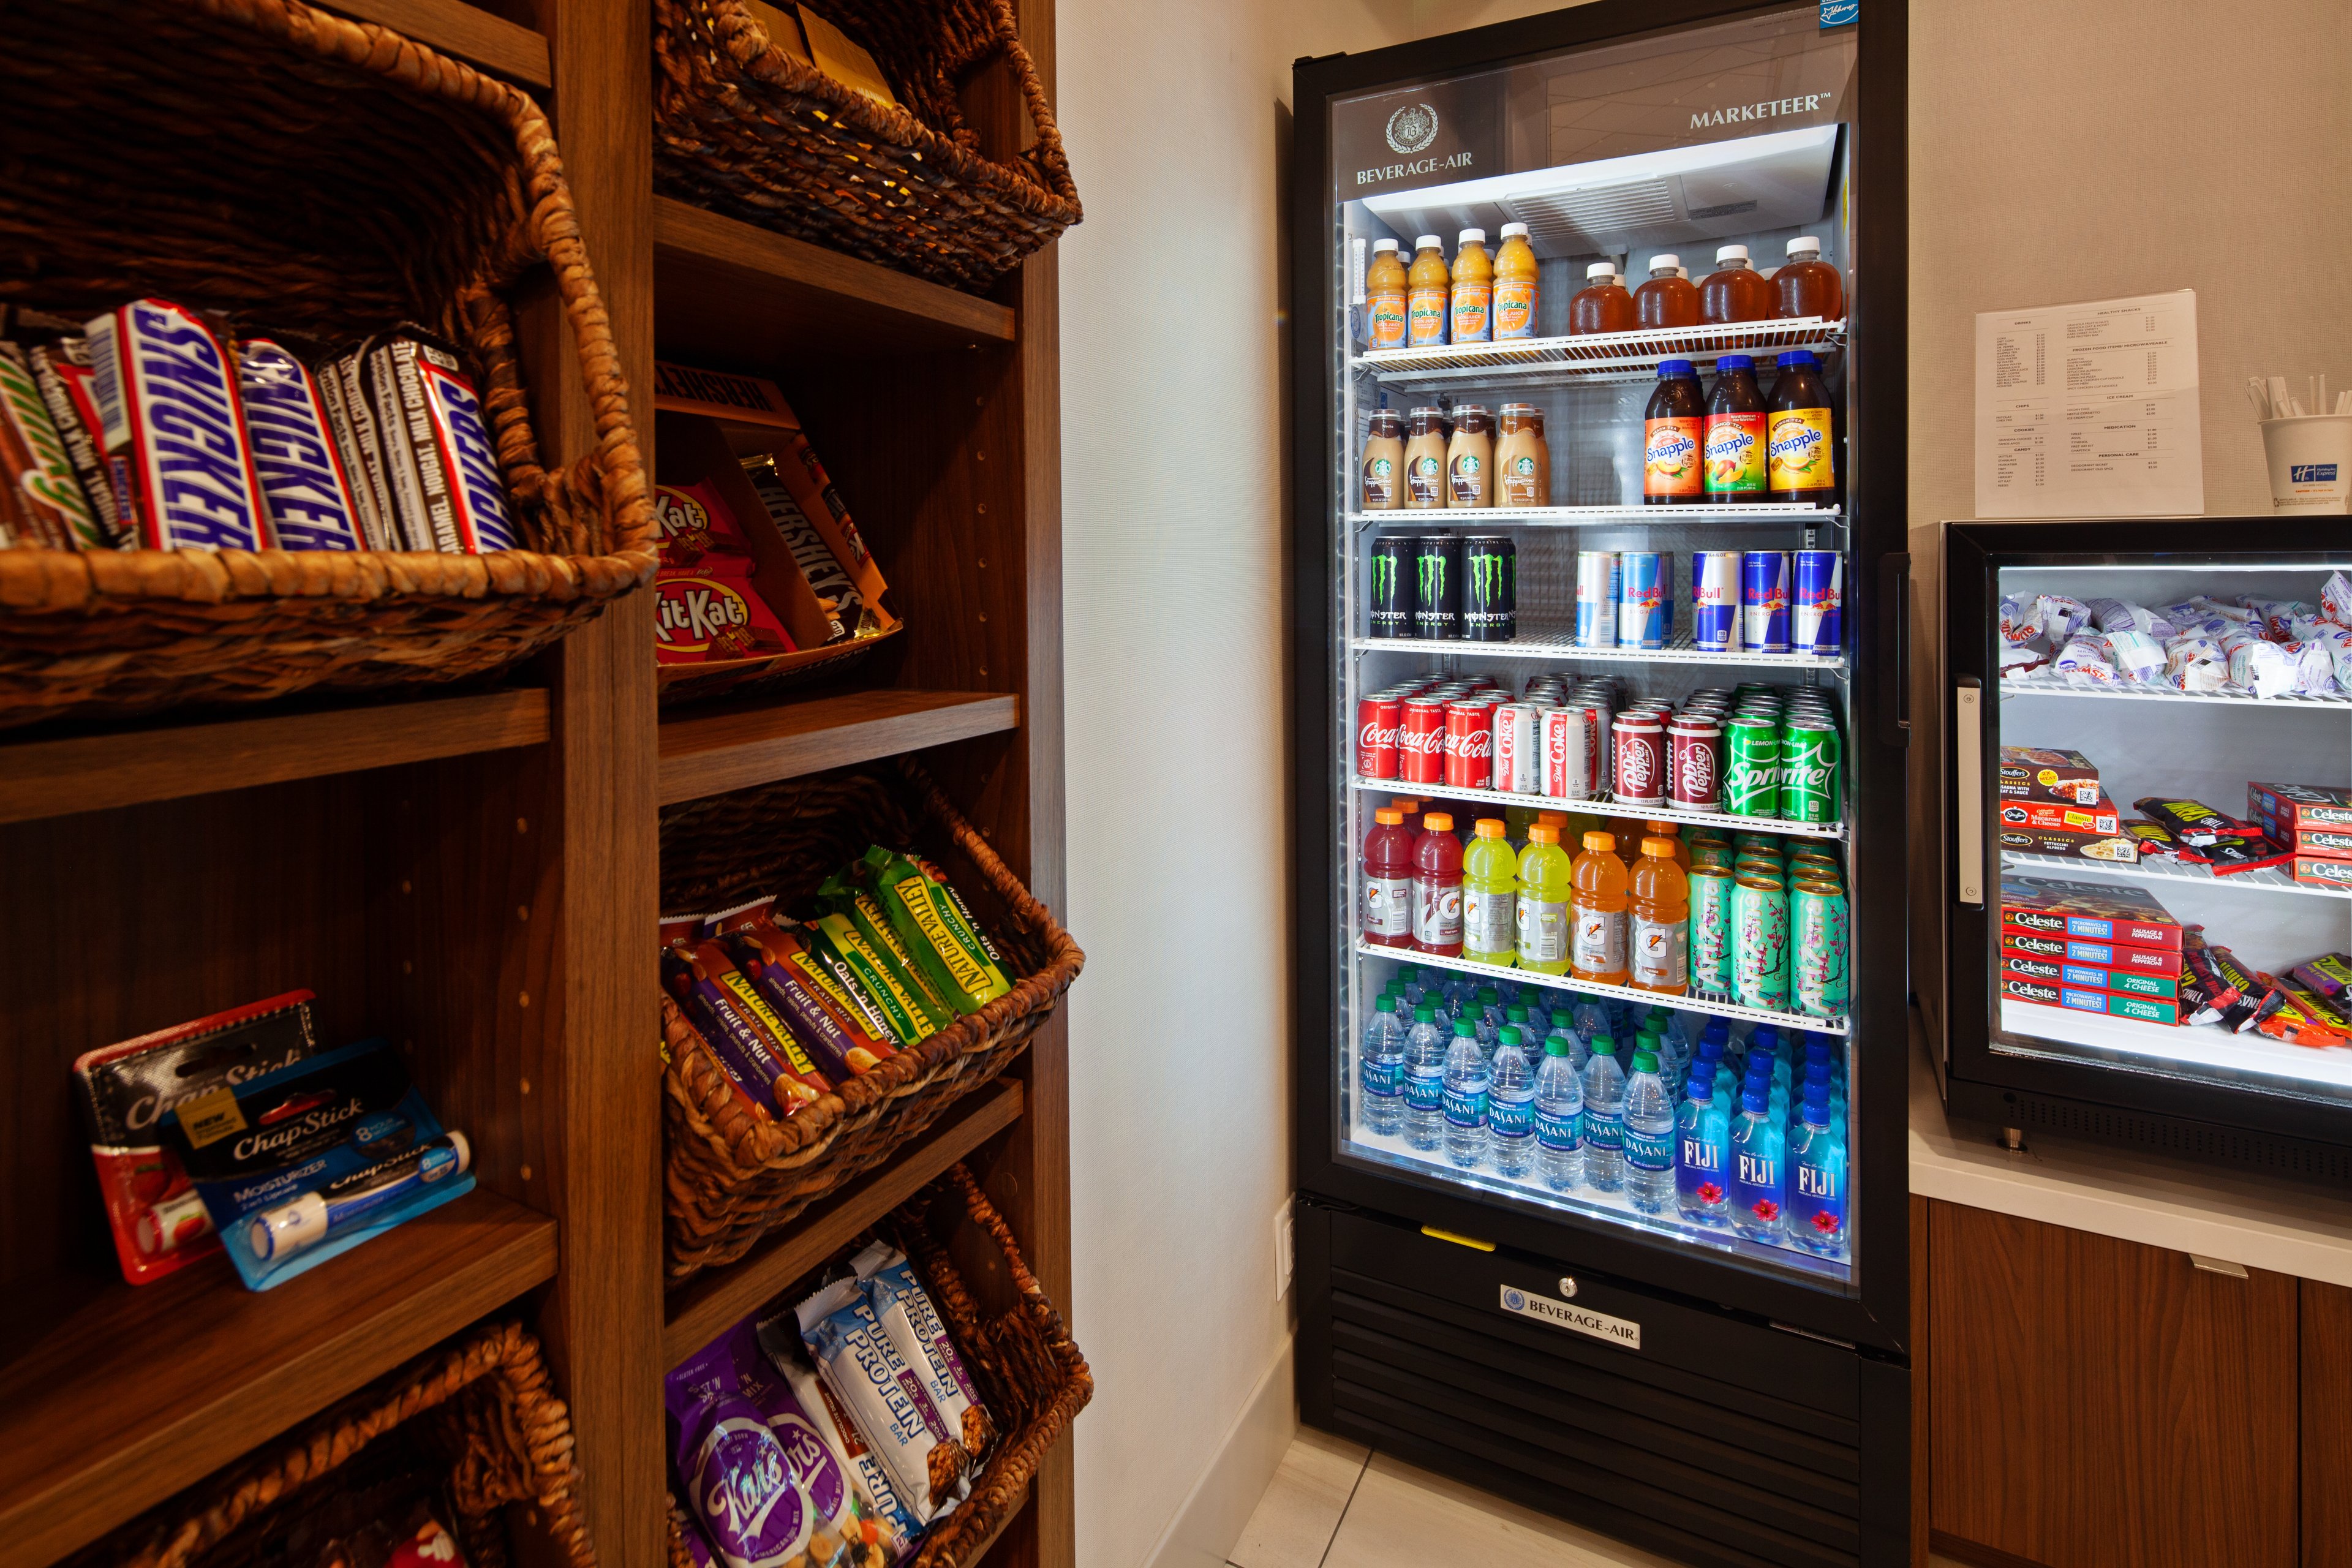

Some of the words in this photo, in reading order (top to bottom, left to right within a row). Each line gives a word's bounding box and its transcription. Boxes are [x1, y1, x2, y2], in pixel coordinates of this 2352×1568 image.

[1357, 152, 1473, 185] BEVERAGE-AIR
[1374, 313, 1404, 323] Tropicana
[1411, 309, 1441, 319] Tropicana
[1455, 304, 1485, 315] Tropicana
[1498, 301, 1528, 311] Tropicana
[391, 341, 425, 410] CHOCOLATE
[408, 409, 434, 442] MILK
[1647, 437, 1695, 462] Snapple
[1705, 433, 1754, 458] Snapple
[1770, 429, 1822, 456] Snapple
[1628, 587, 1651, 598] Red
[1700, 587, 1721, 599] Bull
[1748, 587, 1773, 599] Red
[1800, 587, 1825, 600] Red
[1464, 611, 1509, 622] MONSTER
[1499, 719, 1514, 758] Coke
[1550, 723, 1566, 764] Coke
[1628, 750, 1637, 772] Dr
[1687, 755, 1697, 777] Dr
[1728, 760, 1780, 788] Spri
[2030, 814, 2061, 823] Macaroni
[2067, 813, 2092, 823] Classic
[2002, 835, 2029, 843] Stouffer's
[2312, 862, 2352, 879] Celes
[897, 881, 939, 933] VALLEY
[948, 886, 973, 919] Honey
[939, 903, 976, 950] CRUNCHY
[1579, 916, 1606, 946] G
[2015, 912, 2063, 929] Celeste
[2077, 925, 2108, 935] MINUTES!
[980, 935, 1000, 960] Oats
[1640, 927, 1667, 958] G
[2015, 937, 2063, 954] Celeste
[931, 929, 986, 989] NATURE
[2010, 959, 2058, 976] Celeste
[864, 967, 904, 1020] CRUNCHY
[2008, 981, 2057, 1000] Celeste
[2127, 978, 2157, 987] ORIGINAL
[2130, 984, 2160, 993] CHEESE
[834, 961, 858, 991] Oats
[867, 1005, 899, 1045] Honey
[2066, 992, 2096, 1001] MICROWAVES
[2071, 997, 2102, 1009] MINUTES!
[726, 974, 777, 1023] NATURE
[774, 1022, 811, 1068] VALLEY
[785, 979, 813, 1008] Fruit
[809, 1006, 821, 1017] &
[819, 1015, 842, 1039] Nut
[714, 997, 743, 1029] Fruit
[739, 1027, 752, 1040] &
[747, 1038, 772, 1065] Nut
[819, 1031, 843, 1058] cranberries
[1404, 1085, 1439, 1099] DASANI
[1442, 1096, 1475, 1115] DASANI
[1490, 1107, 1526, 1126] DASANI
[193, 1112, 225, 1132] NEW
[233, 1097, 364, 1161] ChapStick
[1535, 1119, 1572, 1138] DASANI
[1626, 1137, 1667, 1158] DASANI
[1684, 1139, 1719, 1169] FIJI
[1739, 1155, 1775, 1185] FIJI
[1798, 1166, 1836, 1197] FIJI
[899, 1269, 943, 1335] PURE
[851, 1302, 906, 1372] PURE
[894, 1288, 959, 1398] PROTEIN
[843, 1327, 926, 1439] PROTEIN
[930, 1379, 946, 1403] BAR
[889, 1422, 909, 1447] BAR
